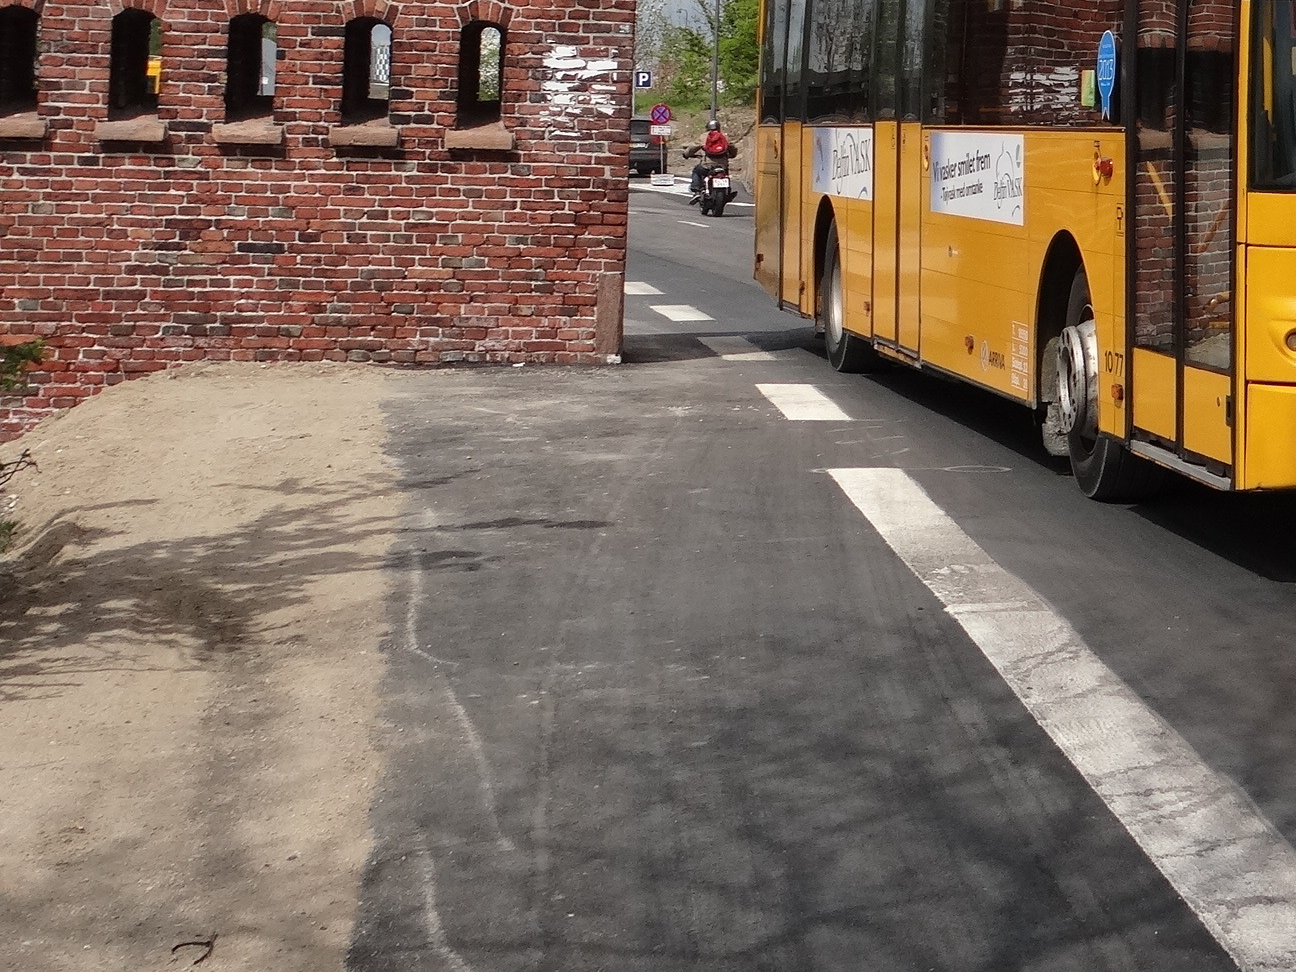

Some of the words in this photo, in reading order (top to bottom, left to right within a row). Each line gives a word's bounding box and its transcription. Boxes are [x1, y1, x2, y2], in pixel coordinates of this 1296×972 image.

[639, 73, 649, 86] P
[940, 158, 957, 181] vasker
[976, 149, 991, 172] frem
[1104, 350, 1124, 377] 1077
